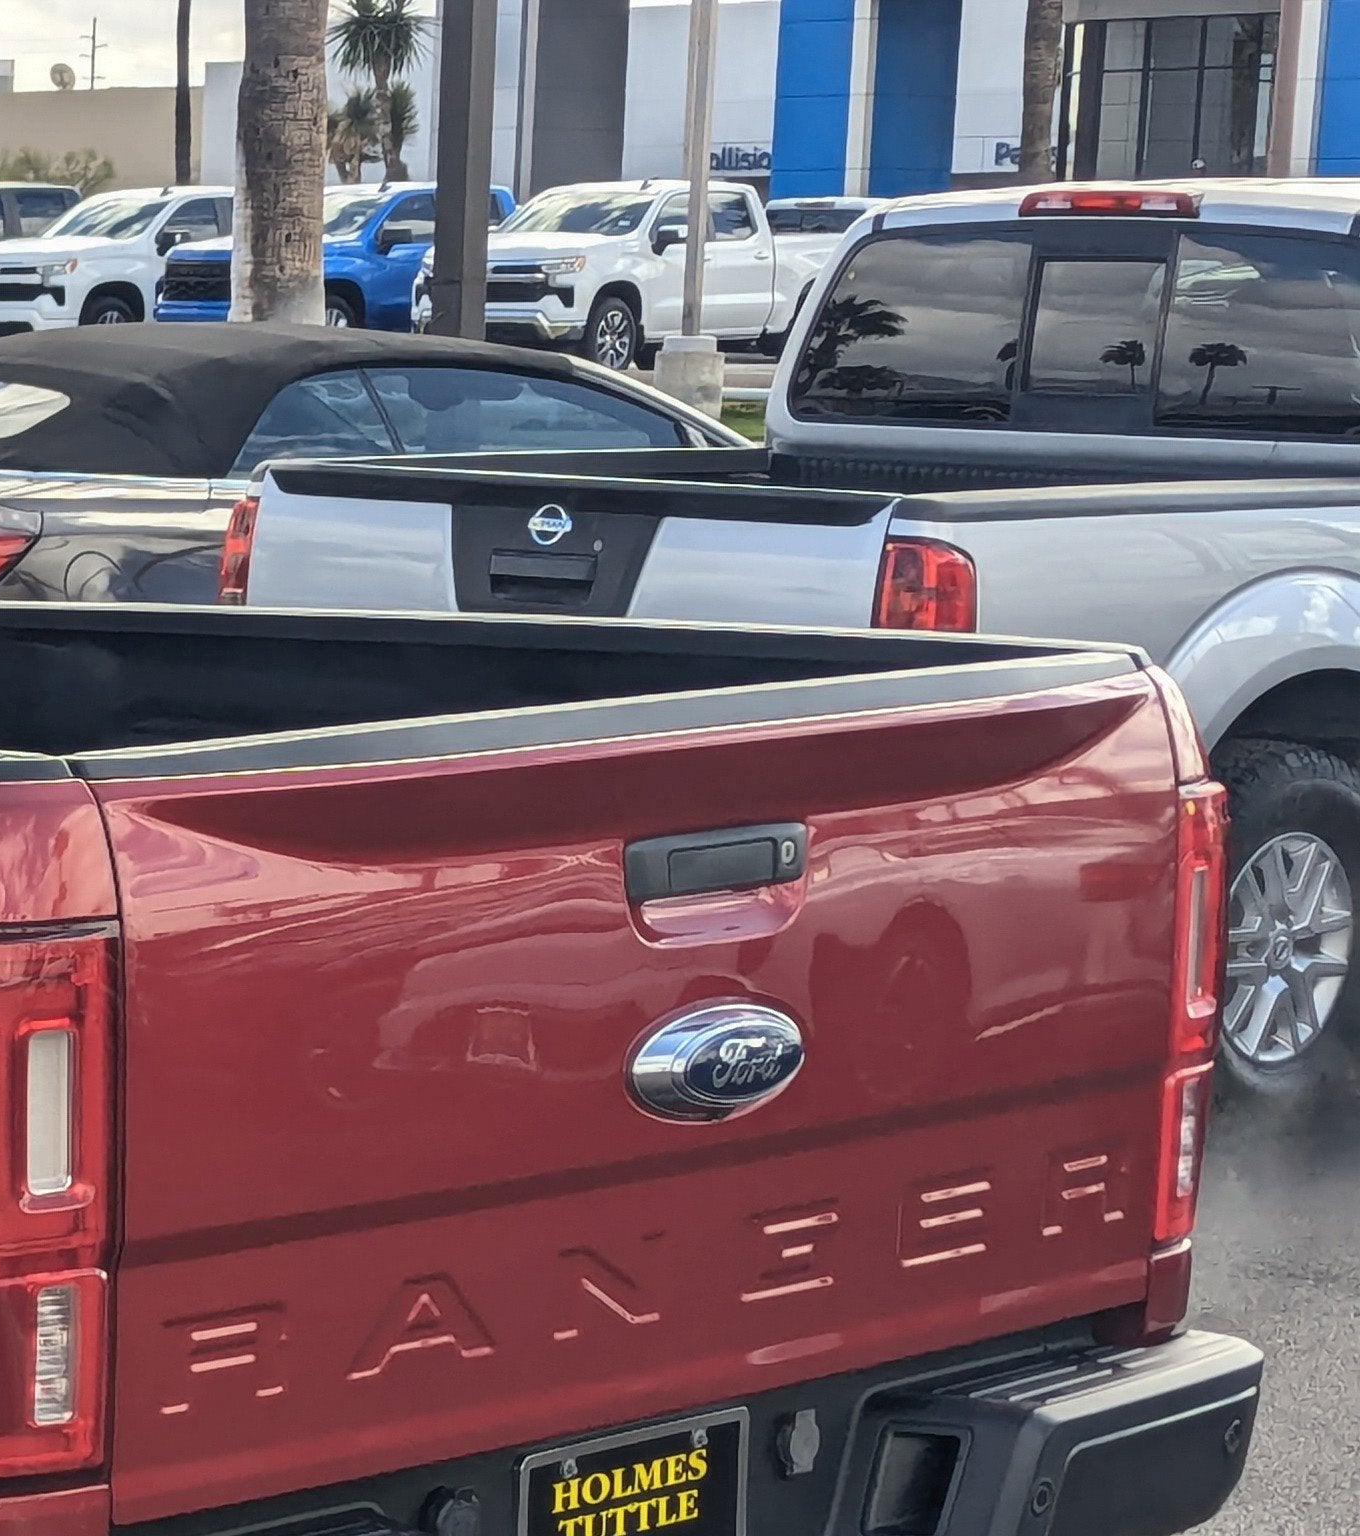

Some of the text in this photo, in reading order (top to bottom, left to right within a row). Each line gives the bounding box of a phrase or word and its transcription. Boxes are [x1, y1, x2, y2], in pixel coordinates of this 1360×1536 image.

[710, 146, 772, 170] ollisio
[712, 1036, 784, 1088] Ford
[160, 1152, 1128, 1415] RANGER
[551, 1448, 708, 1514] HOLMES
